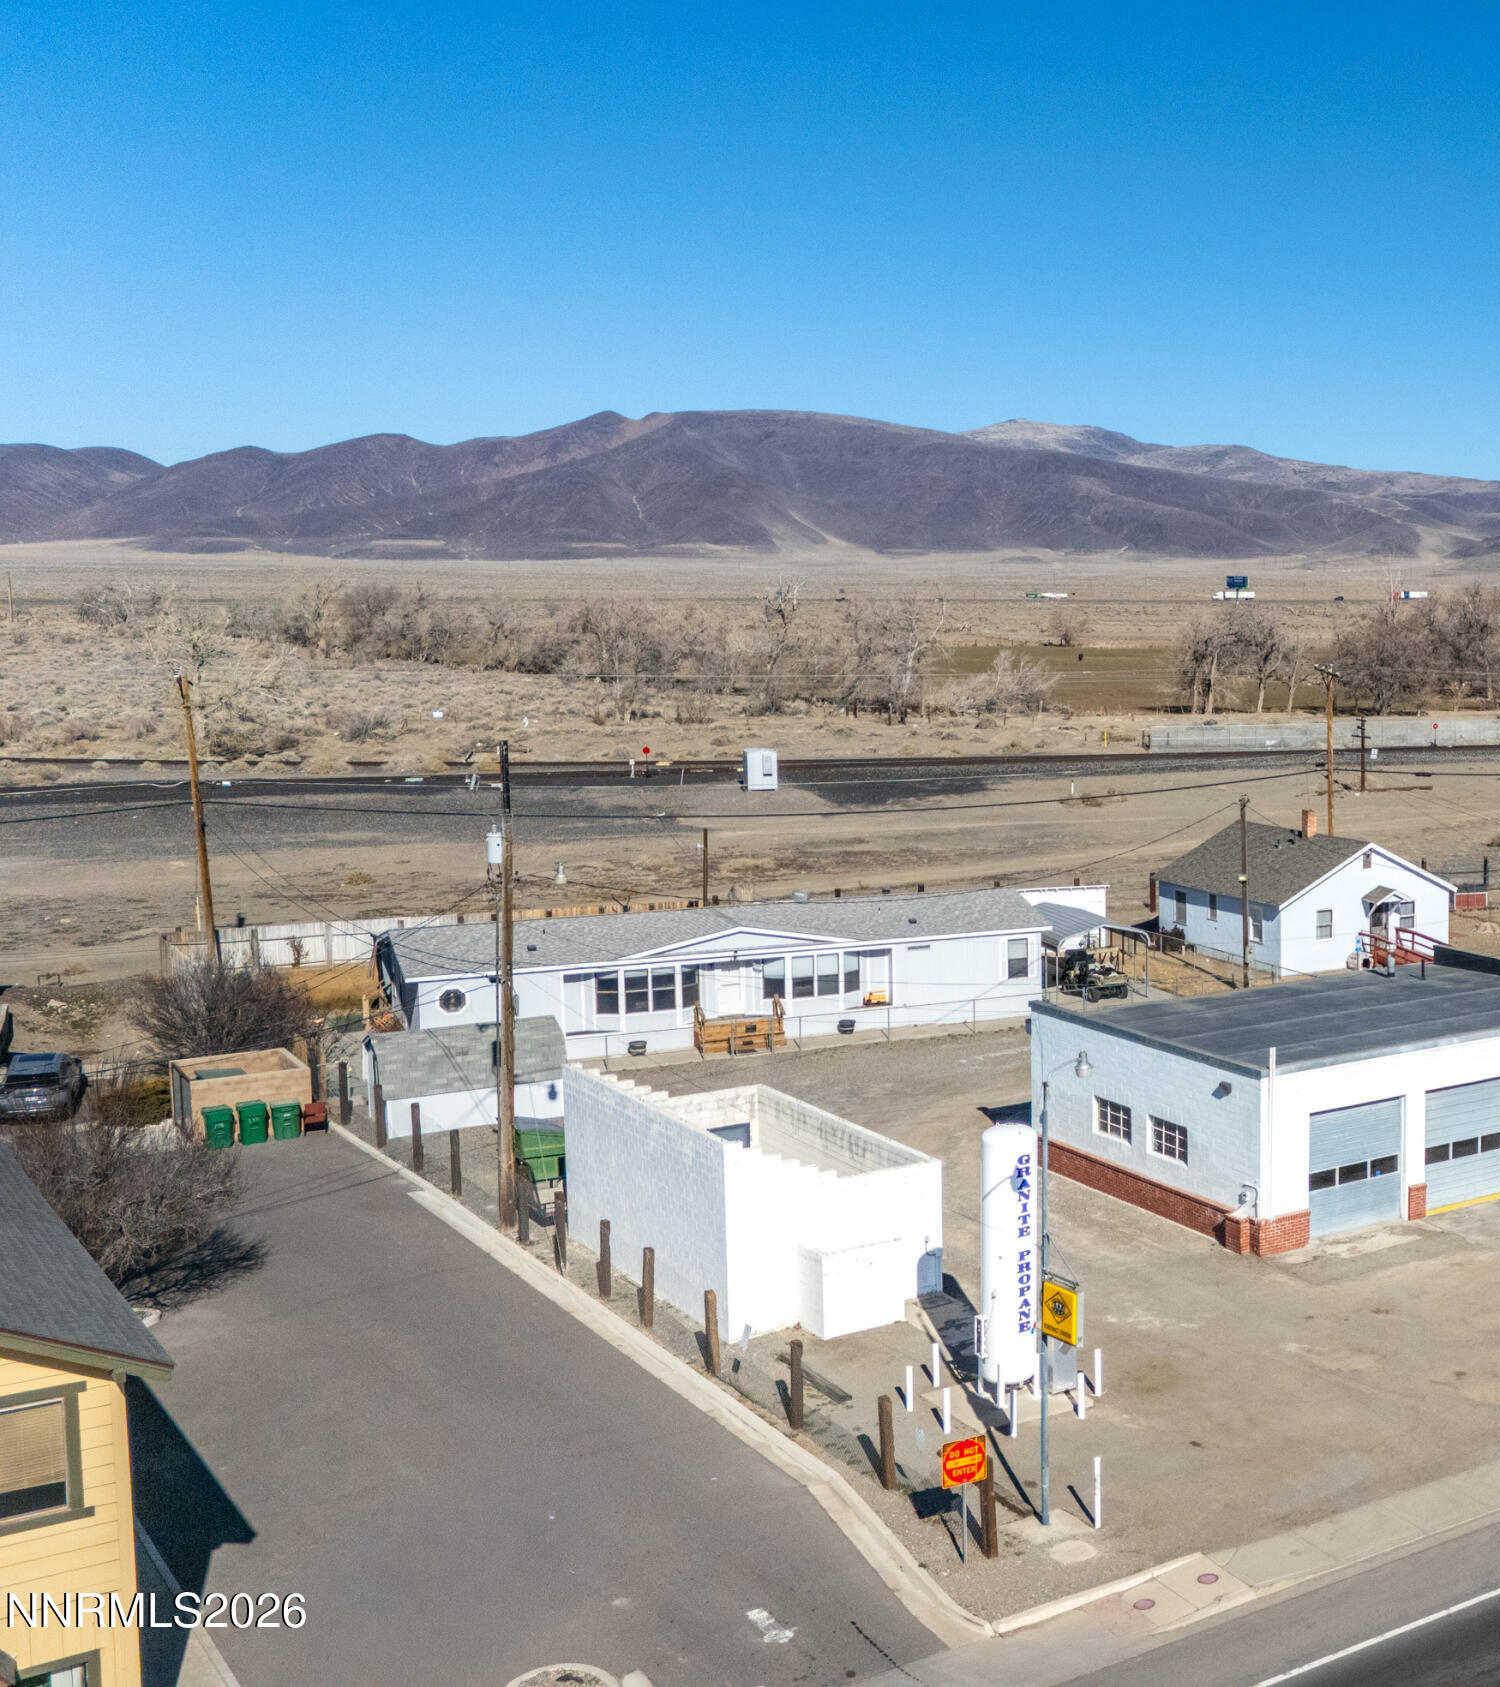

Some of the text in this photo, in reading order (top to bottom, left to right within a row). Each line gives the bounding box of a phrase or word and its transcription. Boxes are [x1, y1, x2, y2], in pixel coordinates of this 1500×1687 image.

[1016, 1154, 1031, 1334] GRANITE PROPANE
[949, 1445, 978, 1459] DO NOT
[952, 1466, 976, 1477] ENTER
